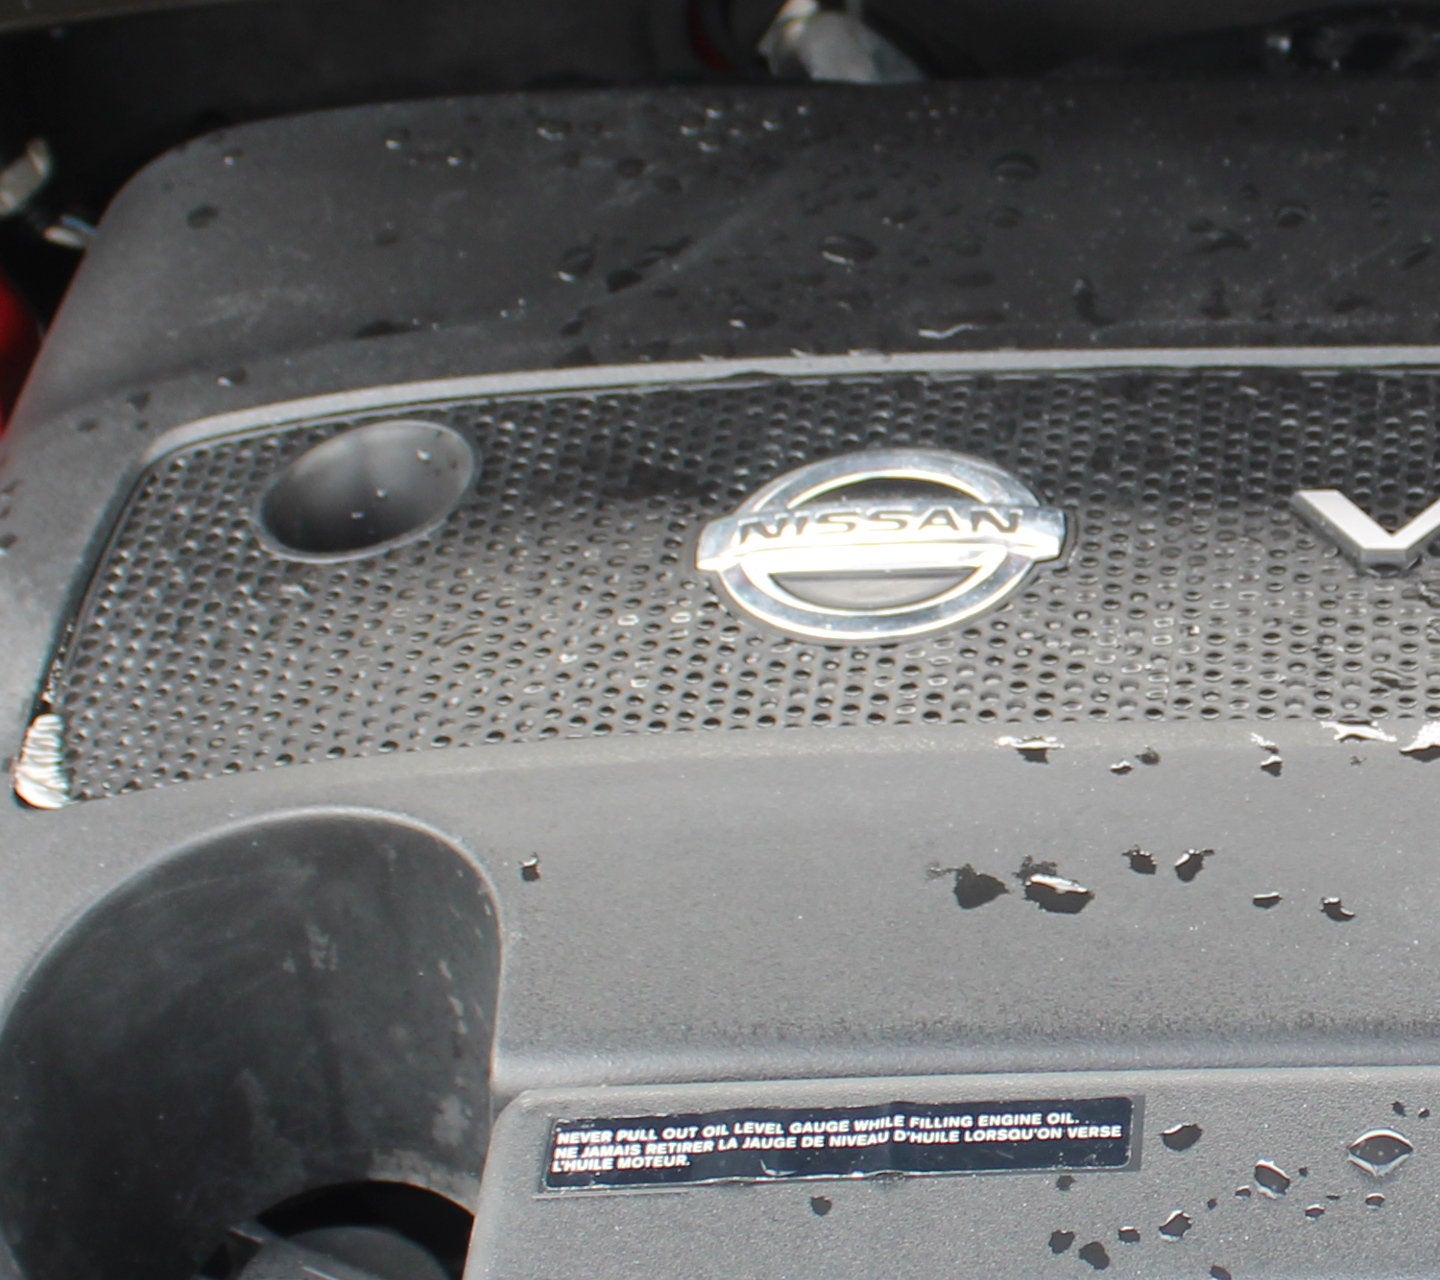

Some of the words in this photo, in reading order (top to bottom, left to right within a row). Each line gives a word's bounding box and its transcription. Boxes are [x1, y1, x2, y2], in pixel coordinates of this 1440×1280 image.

[737, 506, 1024, 546] NISSAN
[553, 1146, 579, 1159] NE
[580, 1144, 641, 1158] JAMAIS
[644, 1140, 714, 1155] RETIRER
[717, 1137, 738, 1151] LA
[742, 1136, 797, 1150] JAUGE
[801, 1135, 825, 1149] DE
[829, 1131, 890, 1147] NIVEAU
[893, 1130, 960, 1144] D'HUILE
[964, 1128, 1062, 1142] LORSQU'ON
[1067, 1125, 1122, 1138] VERSE
[557, 1130, 613, 1145] NEVER
[615, 1129, 658, 1142] PULL
[662, 1127, 699, 1141] OUT
[702, 1124, 729, 1138] OIL
[733, 1121, 785, 1135] LEVEL
[789, 1120, 849, 1134] GAUGE
[853, 1115, 905, 1132] WHILE
[910, 1115, 973, 1129] FILLING
[978, 1113, 1042, 1127] ENGINE
[1046, 1112, 1080, 1125] OIL.
[551, 1157, 614, 1172] L'HUILE
[616, 1154, 691, 1169] MOTEUR.
